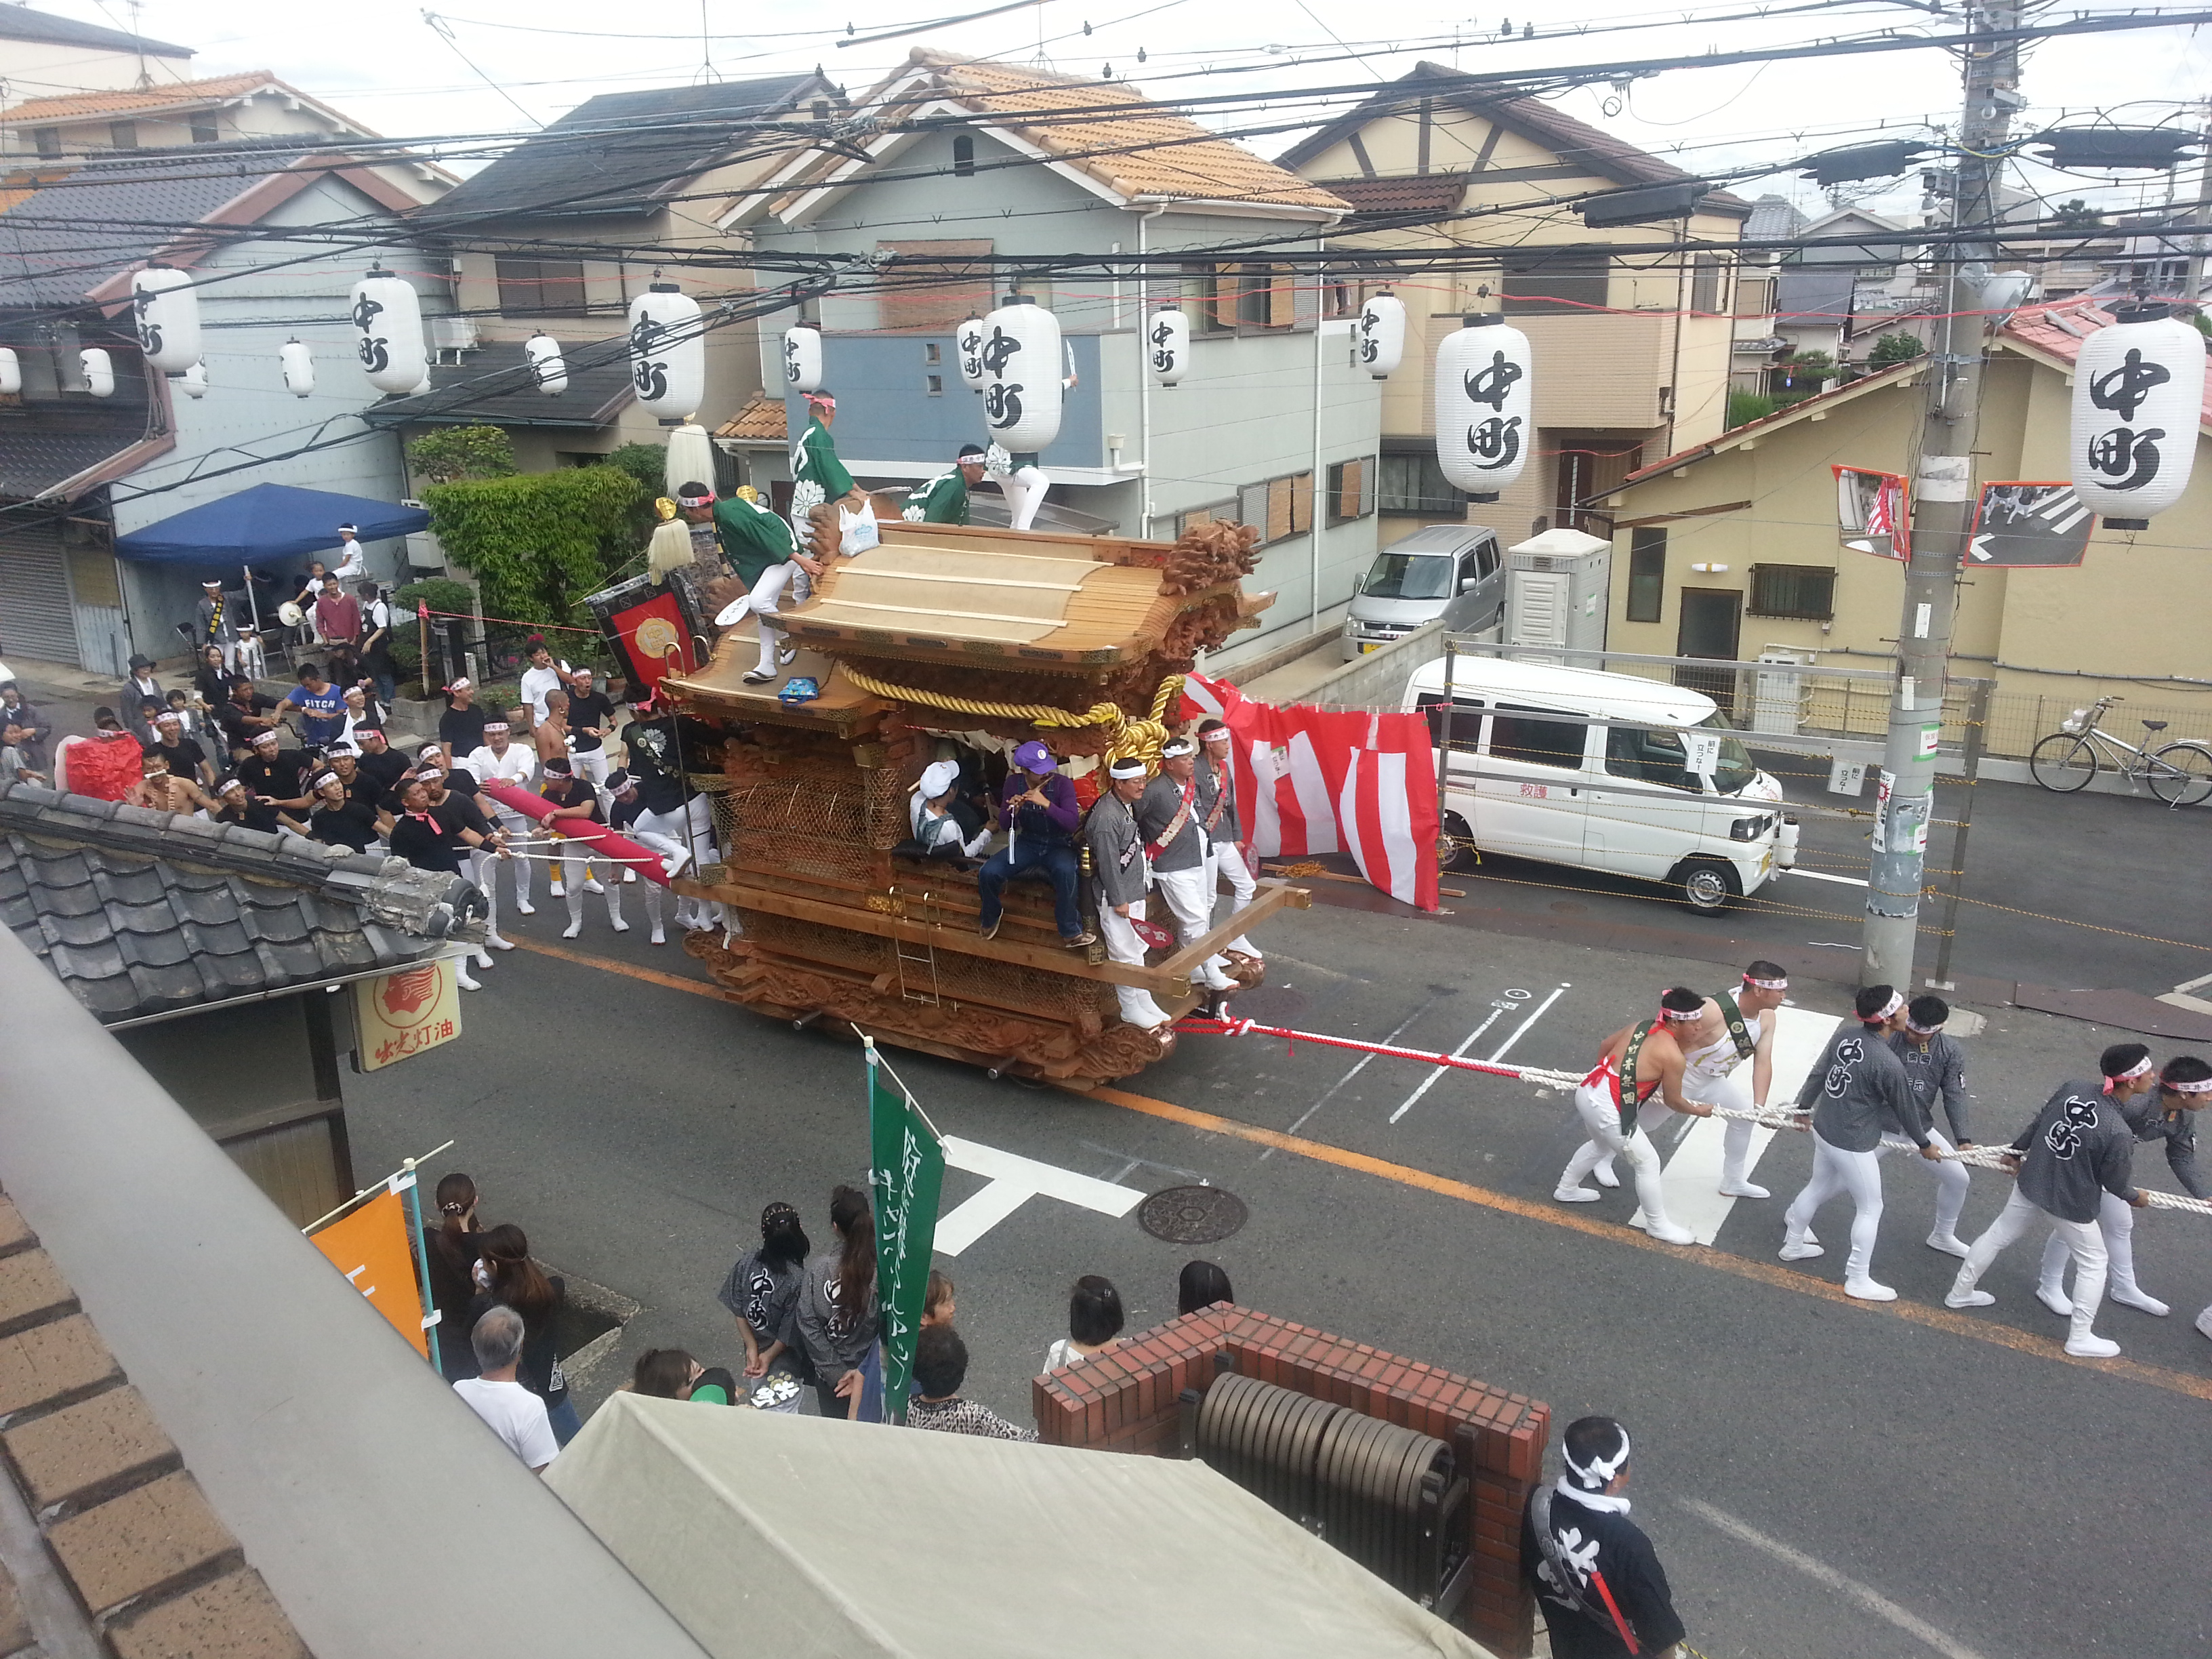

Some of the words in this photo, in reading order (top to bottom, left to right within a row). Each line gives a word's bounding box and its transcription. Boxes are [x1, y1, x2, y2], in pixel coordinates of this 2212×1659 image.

[352, 291, 388, 374] 中町
[630, 309, 670, 401] 中町
[785, 337, 801, 382] 中町
[961, 331, 982, 378] 中町
[1152, 321, 1174, 373] 中町
[1360, 308, 1380, 363] 中町
[983, 325, 1024, 430] 中町
[1464, 350, 1522, 470] 中町
[2088, 348, 2171, 492] 中町
[304, 699, 335, 708] FITCH
[1520, 783, 1548, 799] 救護
[375, 1018, 453, 1064] 出光灯油
[1825, 1038, 1864, 1098] 中町
[2045, 1095, 2098, 1160] 中町
